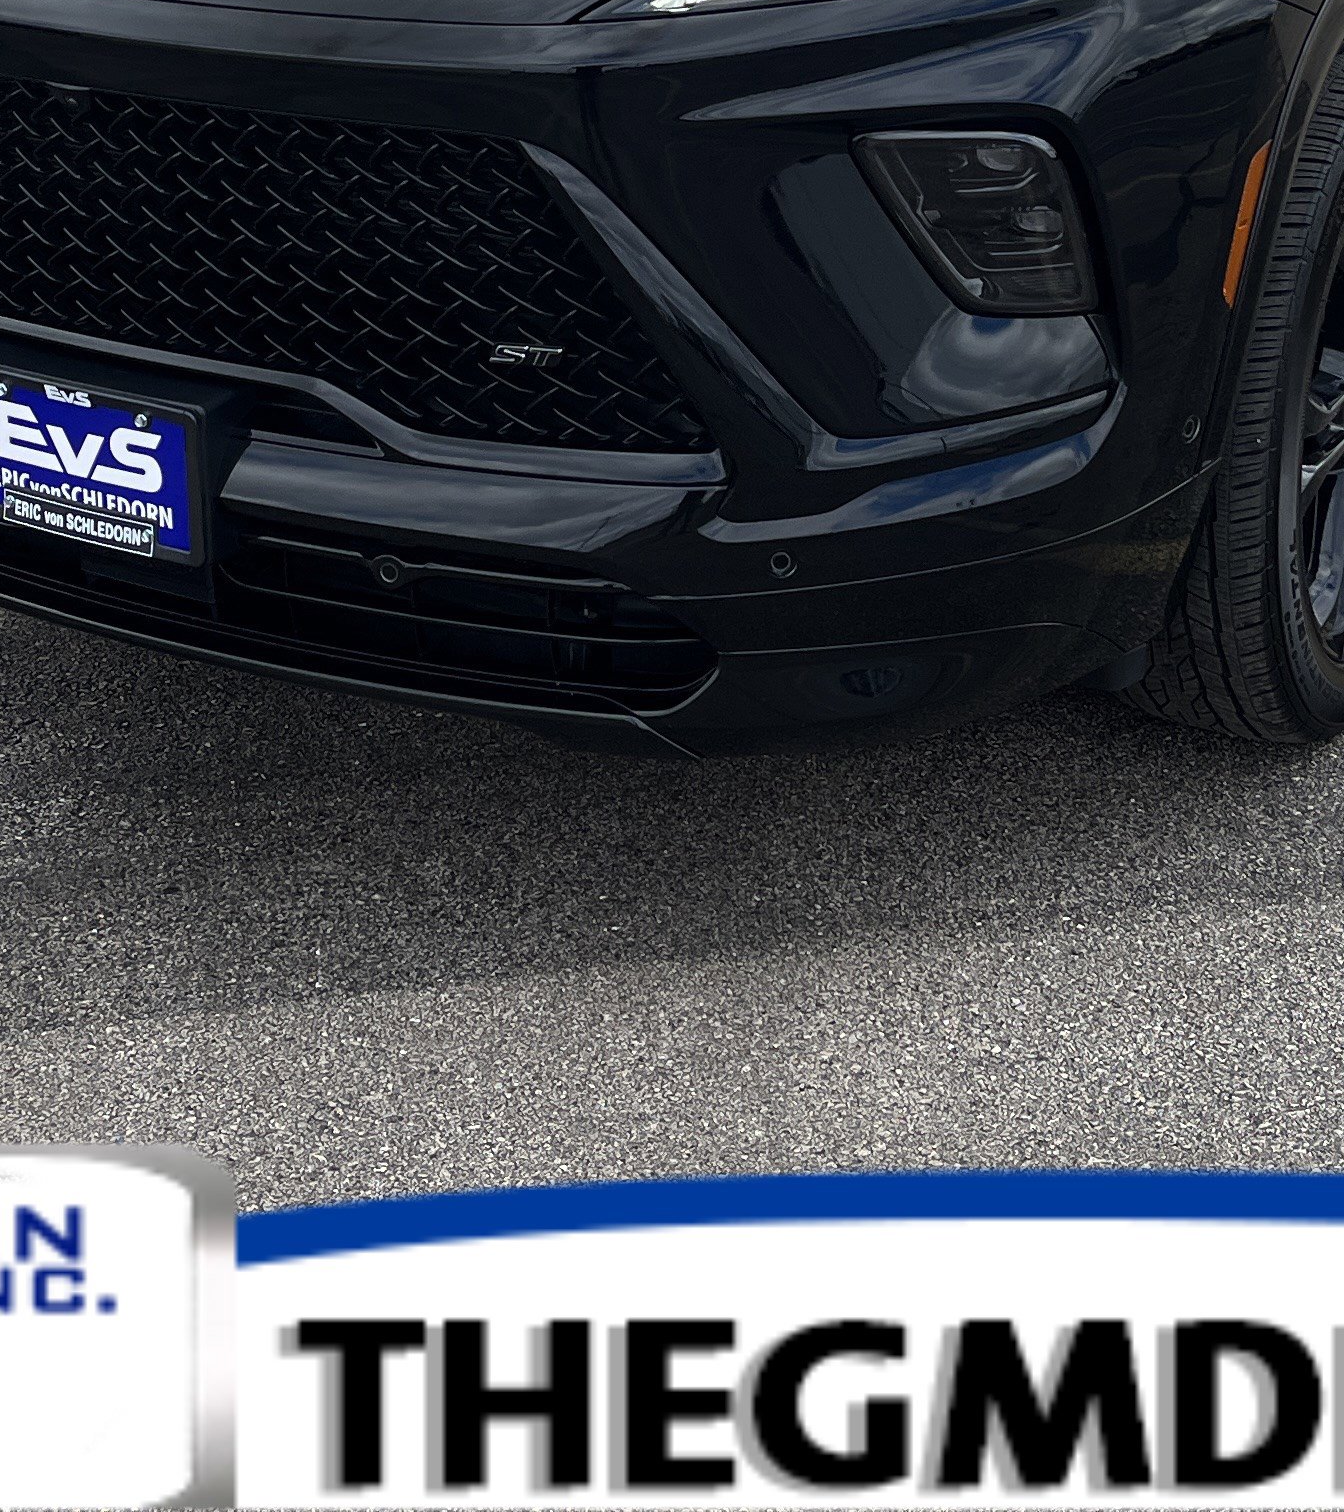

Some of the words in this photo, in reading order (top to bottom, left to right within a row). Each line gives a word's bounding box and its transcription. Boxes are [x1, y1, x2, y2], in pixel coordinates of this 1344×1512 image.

[489, 344, 563, 367] ST
[14, 498, 42, 521] ERIC
[44, 510, 65, 528] von
[65, 512, 142, 547] SCHLEDORN
